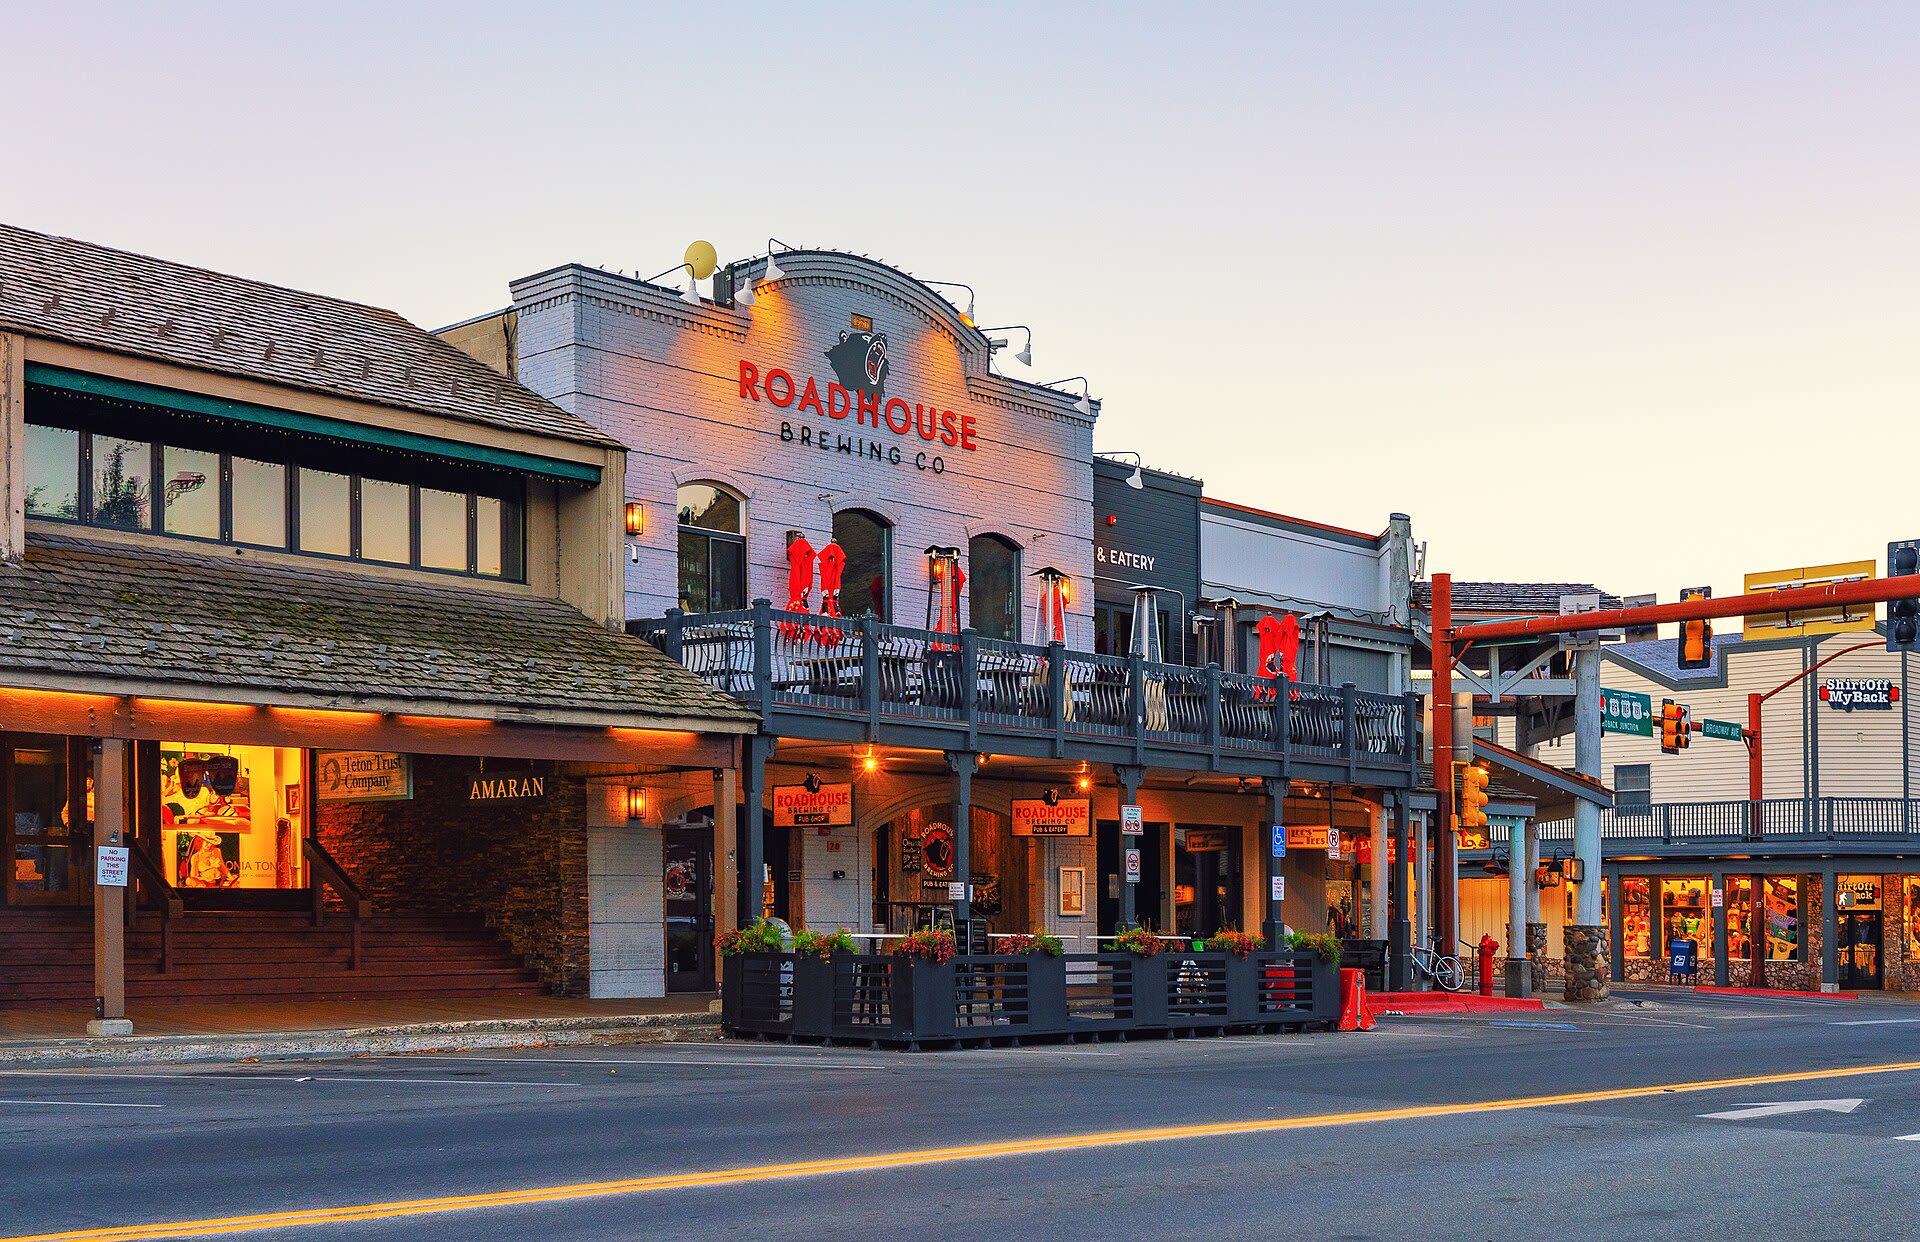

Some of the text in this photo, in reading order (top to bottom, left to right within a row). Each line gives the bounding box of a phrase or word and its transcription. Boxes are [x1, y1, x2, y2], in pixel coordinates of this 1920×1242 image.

[739, 359, 977, 451] ROADHOUSE
[780, 421, 945, 474] BREWING CO
[1096, 546, 1155, 571] & EATERY
[1826, 678, 1890, 691] ShirtOff
[1828, 691, 1889, 705] MyBack
[1705, 724, 1730, 736] BROADWAY
[344, 754, 402, 772] Teton Trust
[344, 773, 391, 792] Company
[469, 777, 545, 800] AMARAN
[776, 792, 849, 807] ROADHOUSE
[788, 805, 838, 814] BREWING CO
[1015, 806, 1086, 819] ROADHOUSE
[921, 822, 954, 839] ROADHOUS
[1306, 835, 1326, 845] TEES
[100, 855, 126, 863] PARKING
[101, 868, 124, 876] STREET
[923, 863, 948, 878] BREWING
[1838, 881, 1874, 891] hirtOff
[1856, 891, 1873, 900] ack
